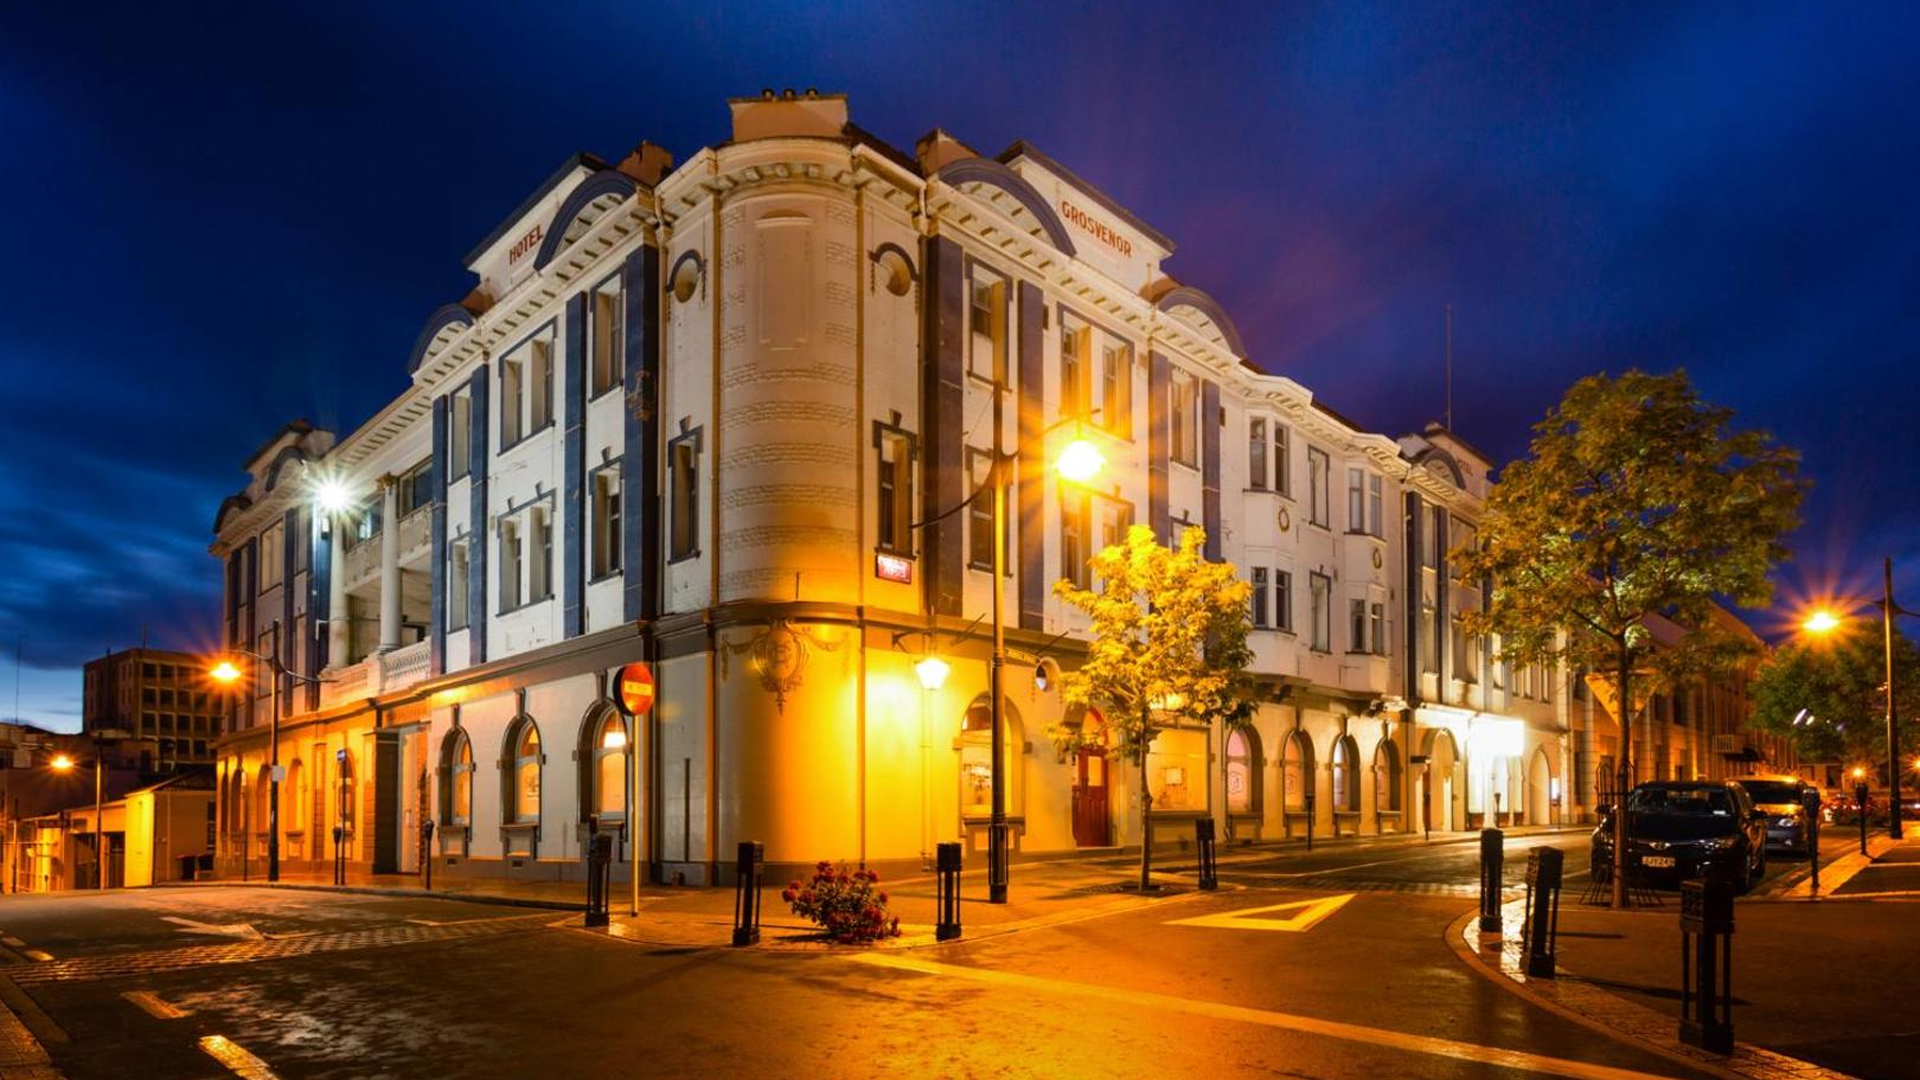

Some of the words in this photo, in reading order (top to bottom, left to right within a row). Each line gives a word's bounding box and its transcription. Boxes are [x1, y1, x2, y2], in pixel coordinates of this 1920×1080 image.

[509, 223, 543, 265] HOTEL
[1061, 200, 1132, 258] GROSVENOR
[1457, 457, 1474, 478] OTEL
